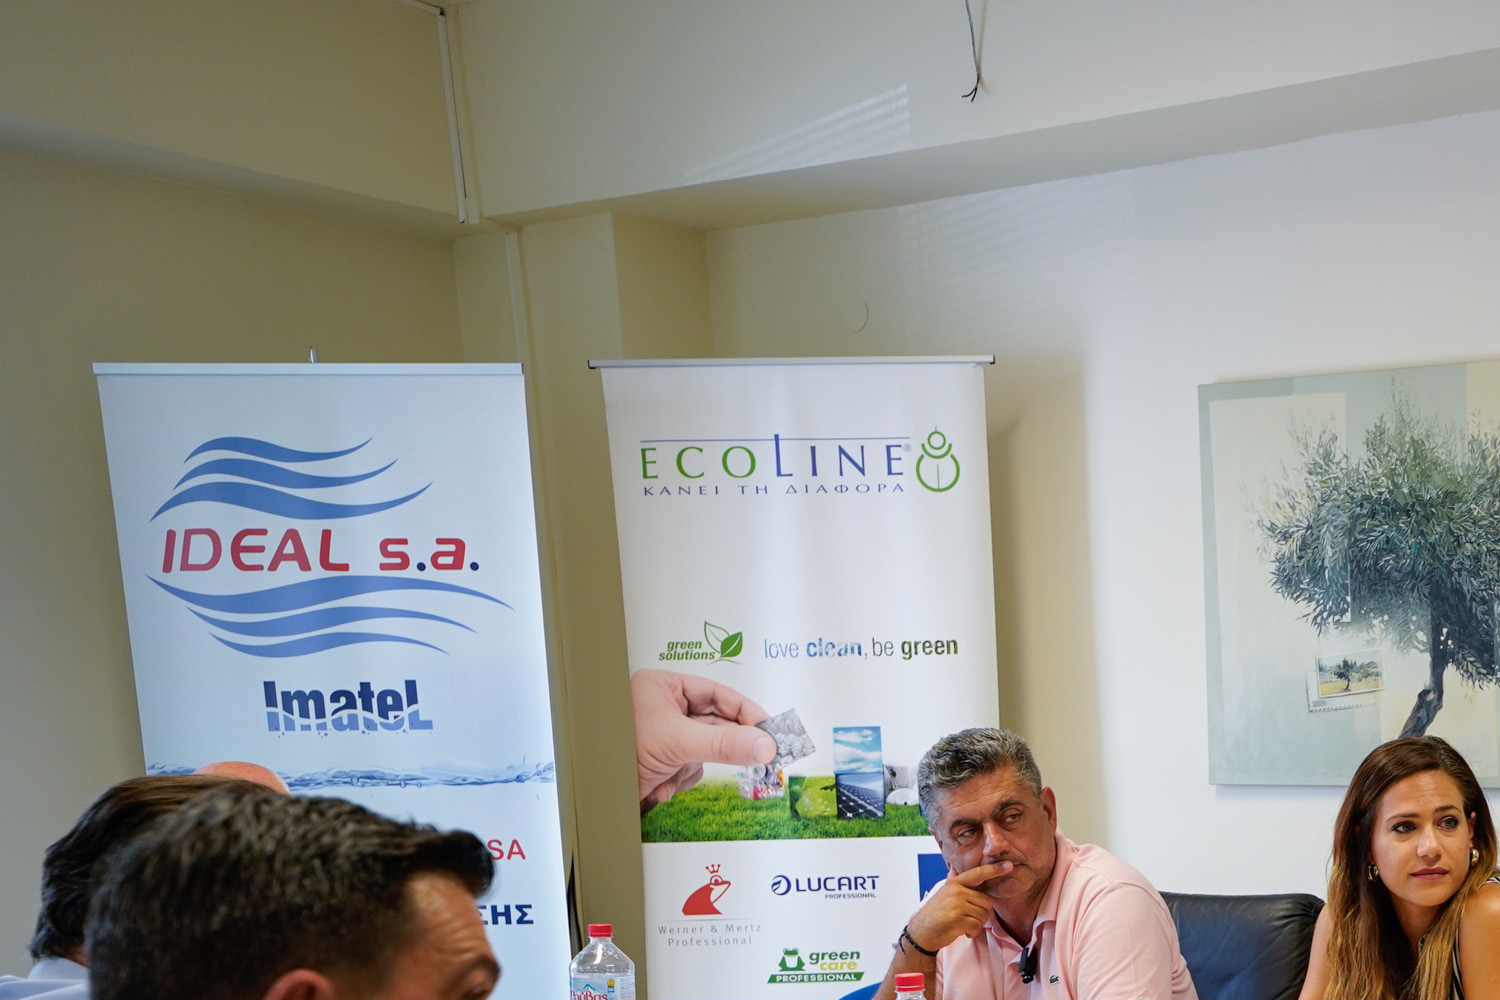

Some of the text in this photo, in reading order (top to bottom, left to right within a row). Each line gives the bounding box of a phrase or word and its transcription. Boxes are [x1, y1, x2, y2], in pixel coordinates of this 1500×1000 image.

[644, 483, 904, 497] ΚΑΝΕΙ ΤΗ ΔΙΑΦΟΡΑ
[162, 528, 480, 573] IDEAL s.a.
[666, 640, 702, 652] green
[764, 638, 799, 658] love
[872, 637, 894, 656] be
[901, 638, 958, 660] green
[658, 648, 715, 661] solutions
[795, 875, 880, 892] LUCART
[658, 923, 762, 934] Werner & Mertz
[668, 936, 752, 947] Professional
[808, 951, 861, 965] green
[820, 961, 858, 971] care
[776, 973, 857, 983] PROFESSIONAL
